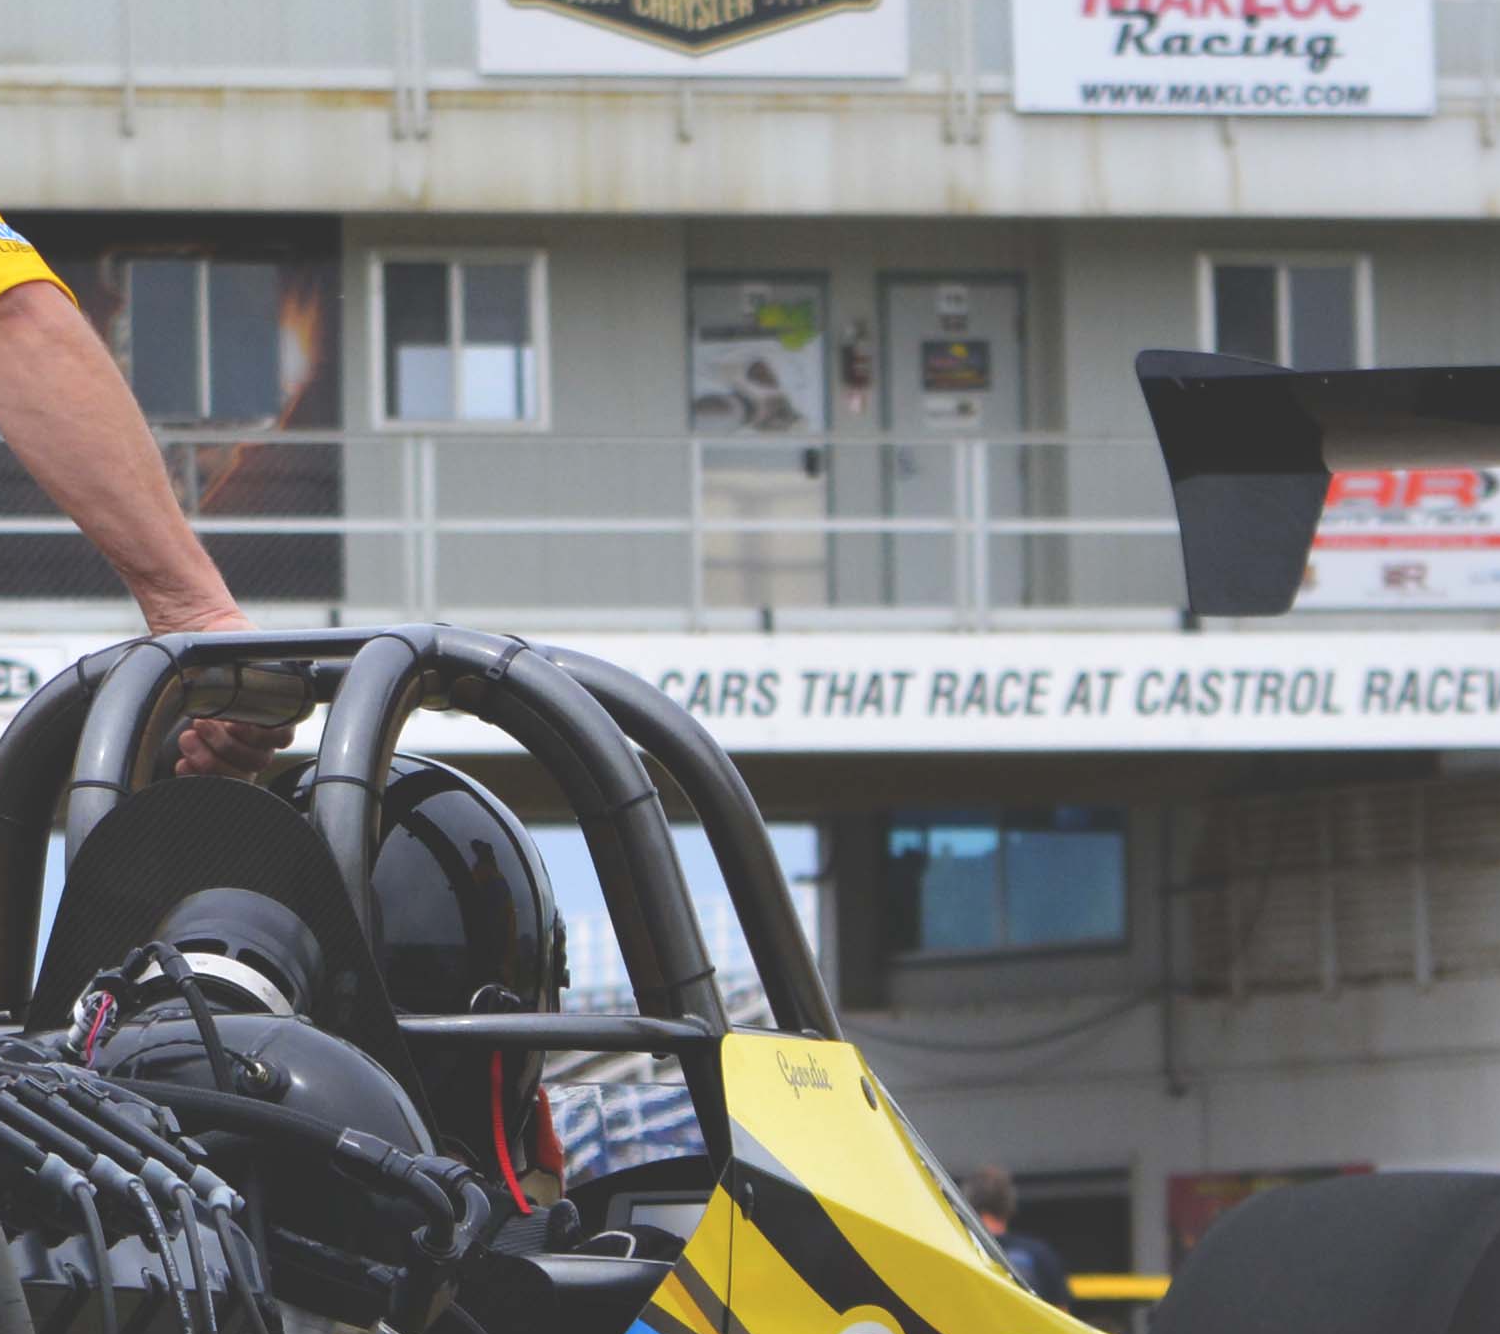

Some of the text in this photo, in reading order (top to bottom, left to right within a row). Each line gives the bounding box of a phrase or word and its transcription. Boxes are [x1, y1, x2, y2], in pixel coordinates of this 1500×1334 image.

[1109, 9, 1344, 73] Racing
[1081, 83, 1370, 106] WWW.MAKLOC.COM
[660, 670, 780, 718] CARS
[799, 670, 910, 718] THAT
[928, 670, 1050, 718] RACE
[1063, 670, 1121, 718] AT
[1138, 669, 1343, 718] CASTROL
